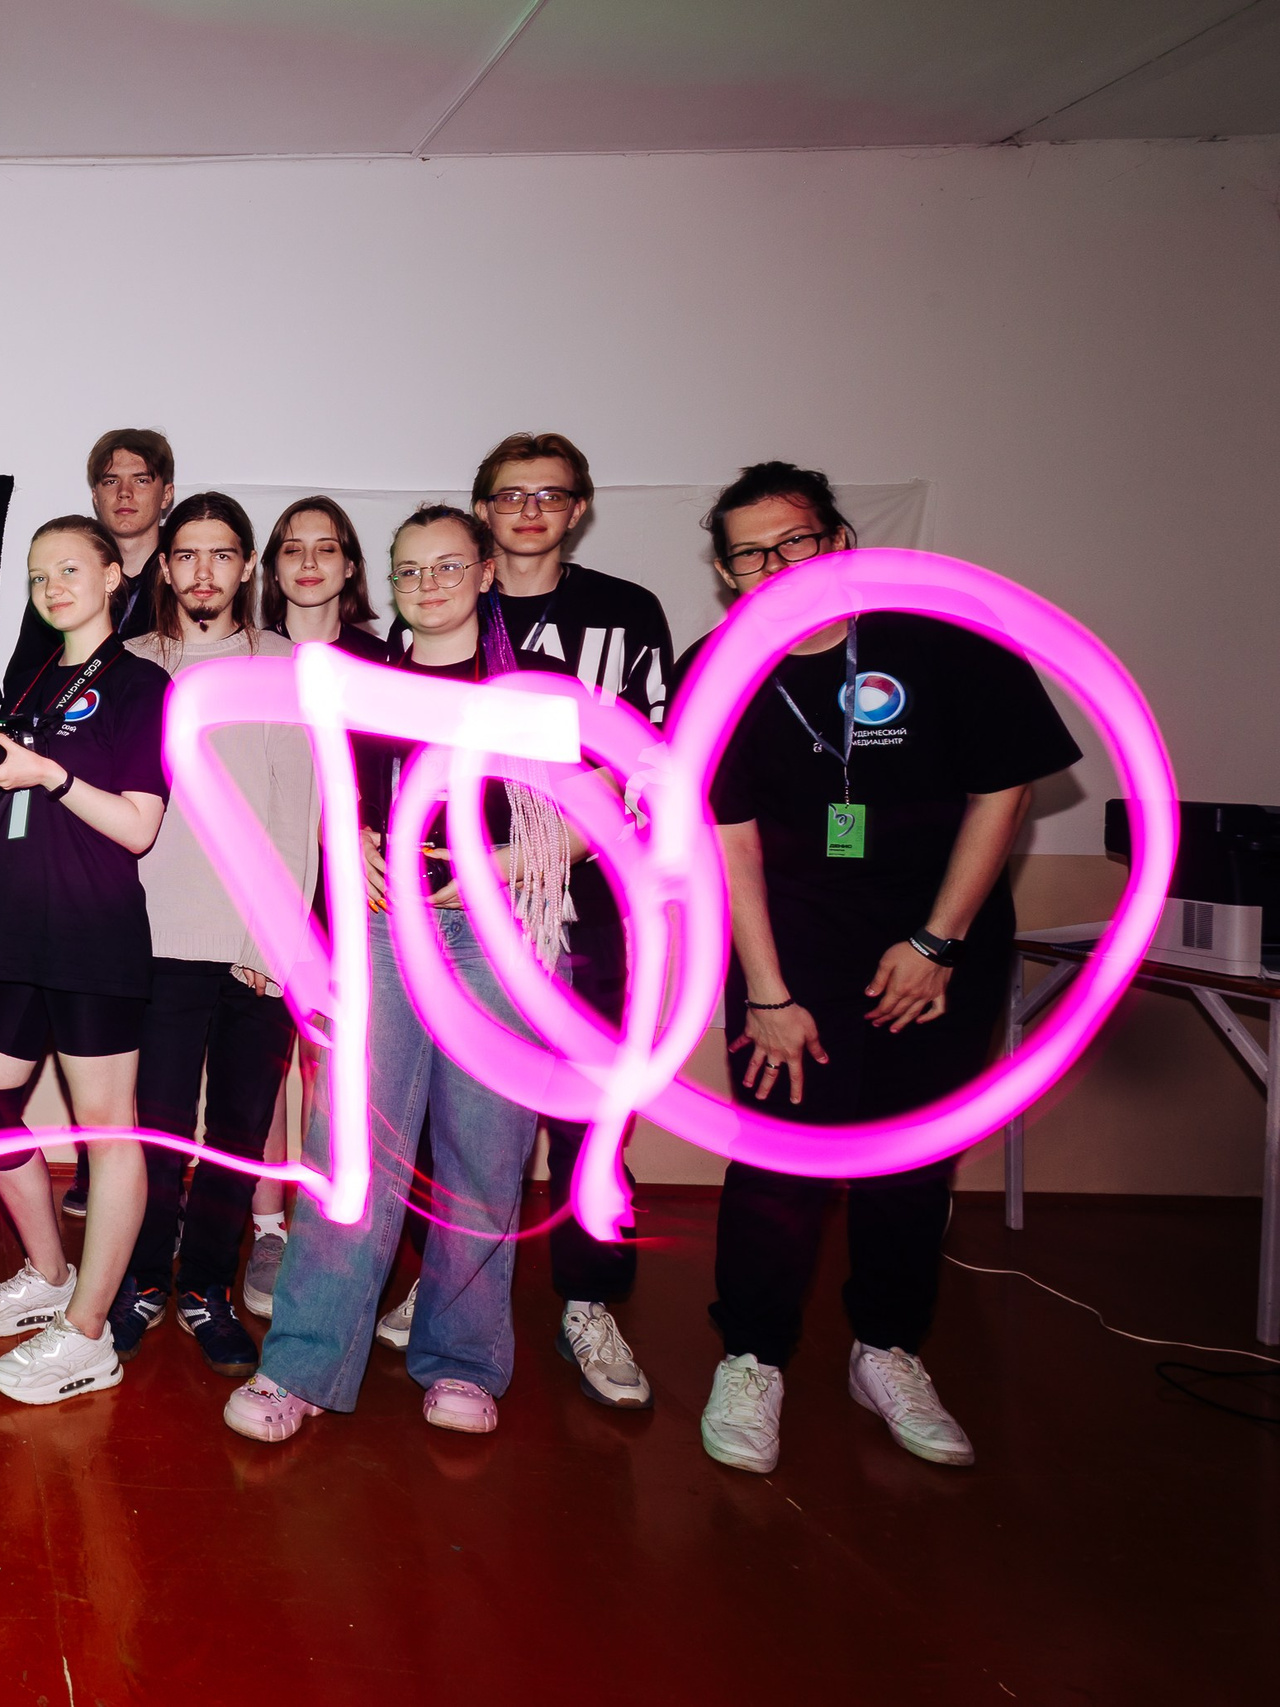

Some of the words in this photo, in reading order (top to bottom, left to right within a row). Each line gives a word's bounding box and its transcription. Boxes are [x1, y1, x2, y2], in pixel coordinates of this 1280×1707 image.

[83, 658, 102, 678] EOS
[55, 677, 86, 709] DIGITAL
[851, 728, 907, 738] УДЕНЧЕСКИЙ
